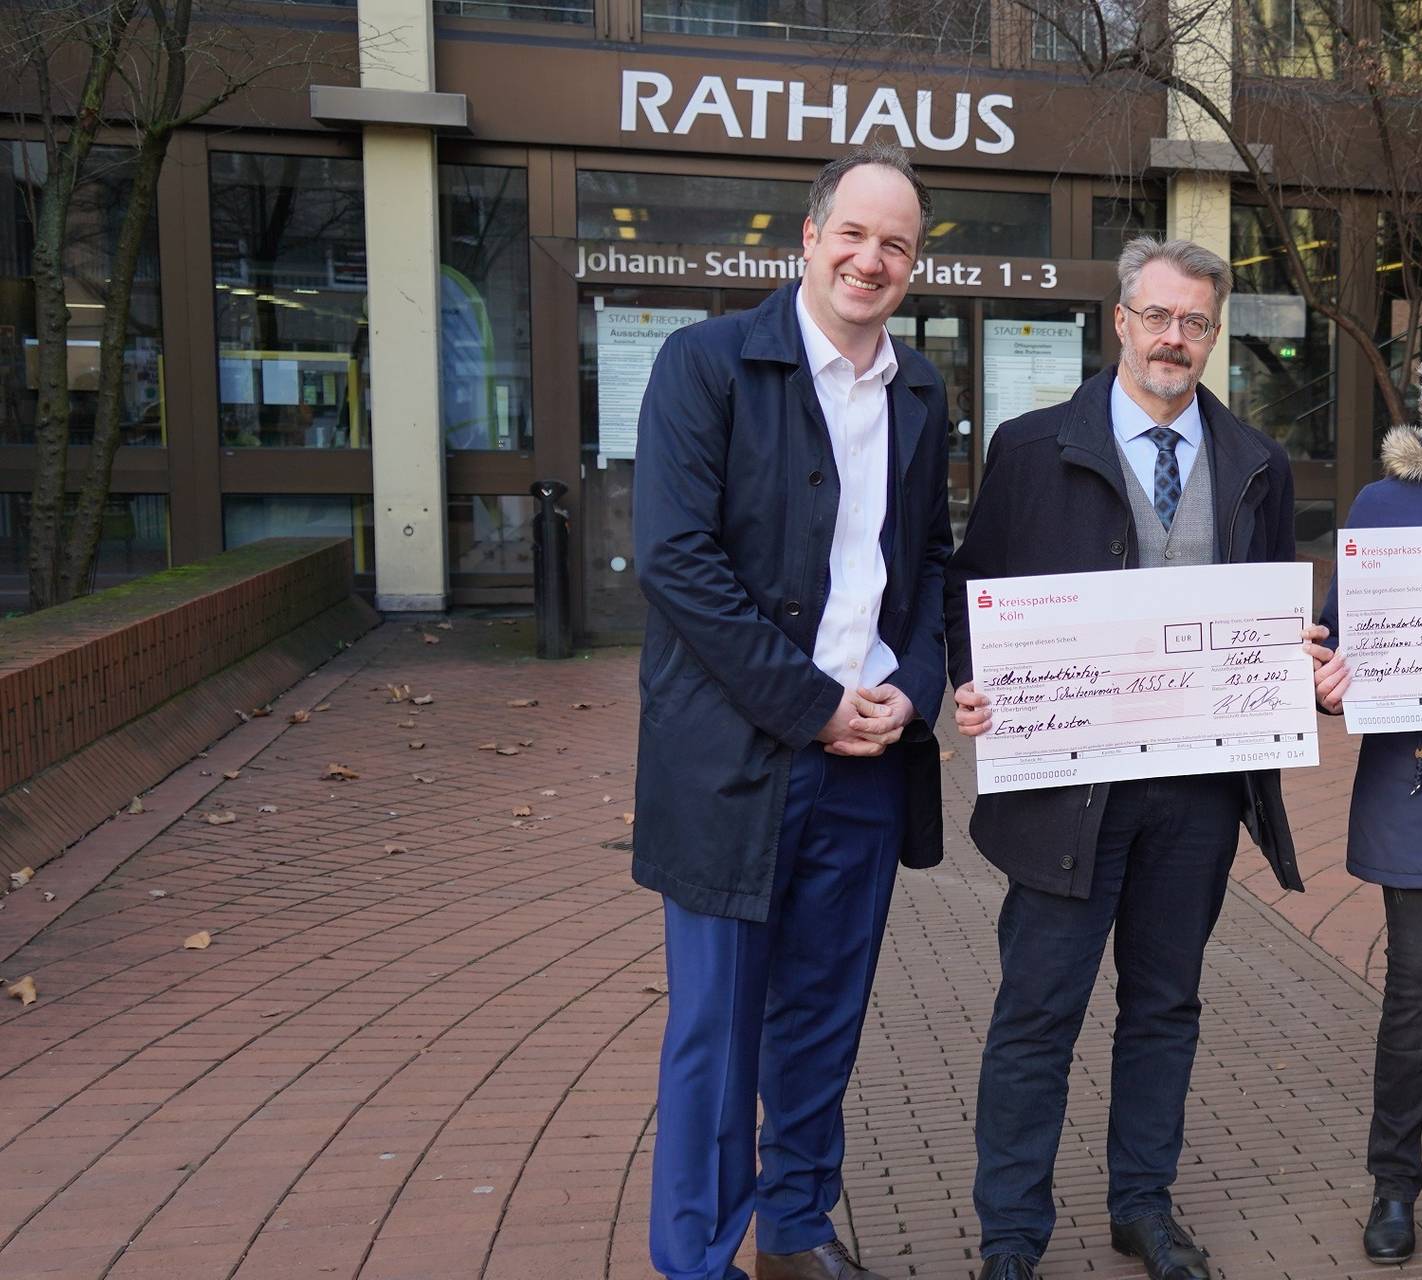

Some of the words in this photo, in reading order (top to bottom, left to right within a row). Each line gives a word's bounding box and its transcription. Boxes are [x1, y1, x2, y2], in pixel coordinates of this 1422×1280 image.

[620, 69, 1015, 154] RATHAUS
[575, 246, 698, 278] Johann-
[1040, 264, 1057, 289] 3
[994, 327, 1021, 335] STADT
[1032, 328, 1072, 336] FRECHEN
[1361, 560, 1381, 569] Köln
[999, 593, 1079, 608] Kreissparkasse
[1000, 611, 1024, 621] Köln
[981, 642, 1002, 650] Zahlen
[1014, 639, 1033, 648] gegen
[1175, 635, 1192, 643] EUR
[1127, 674, 1165, 693] 1655
